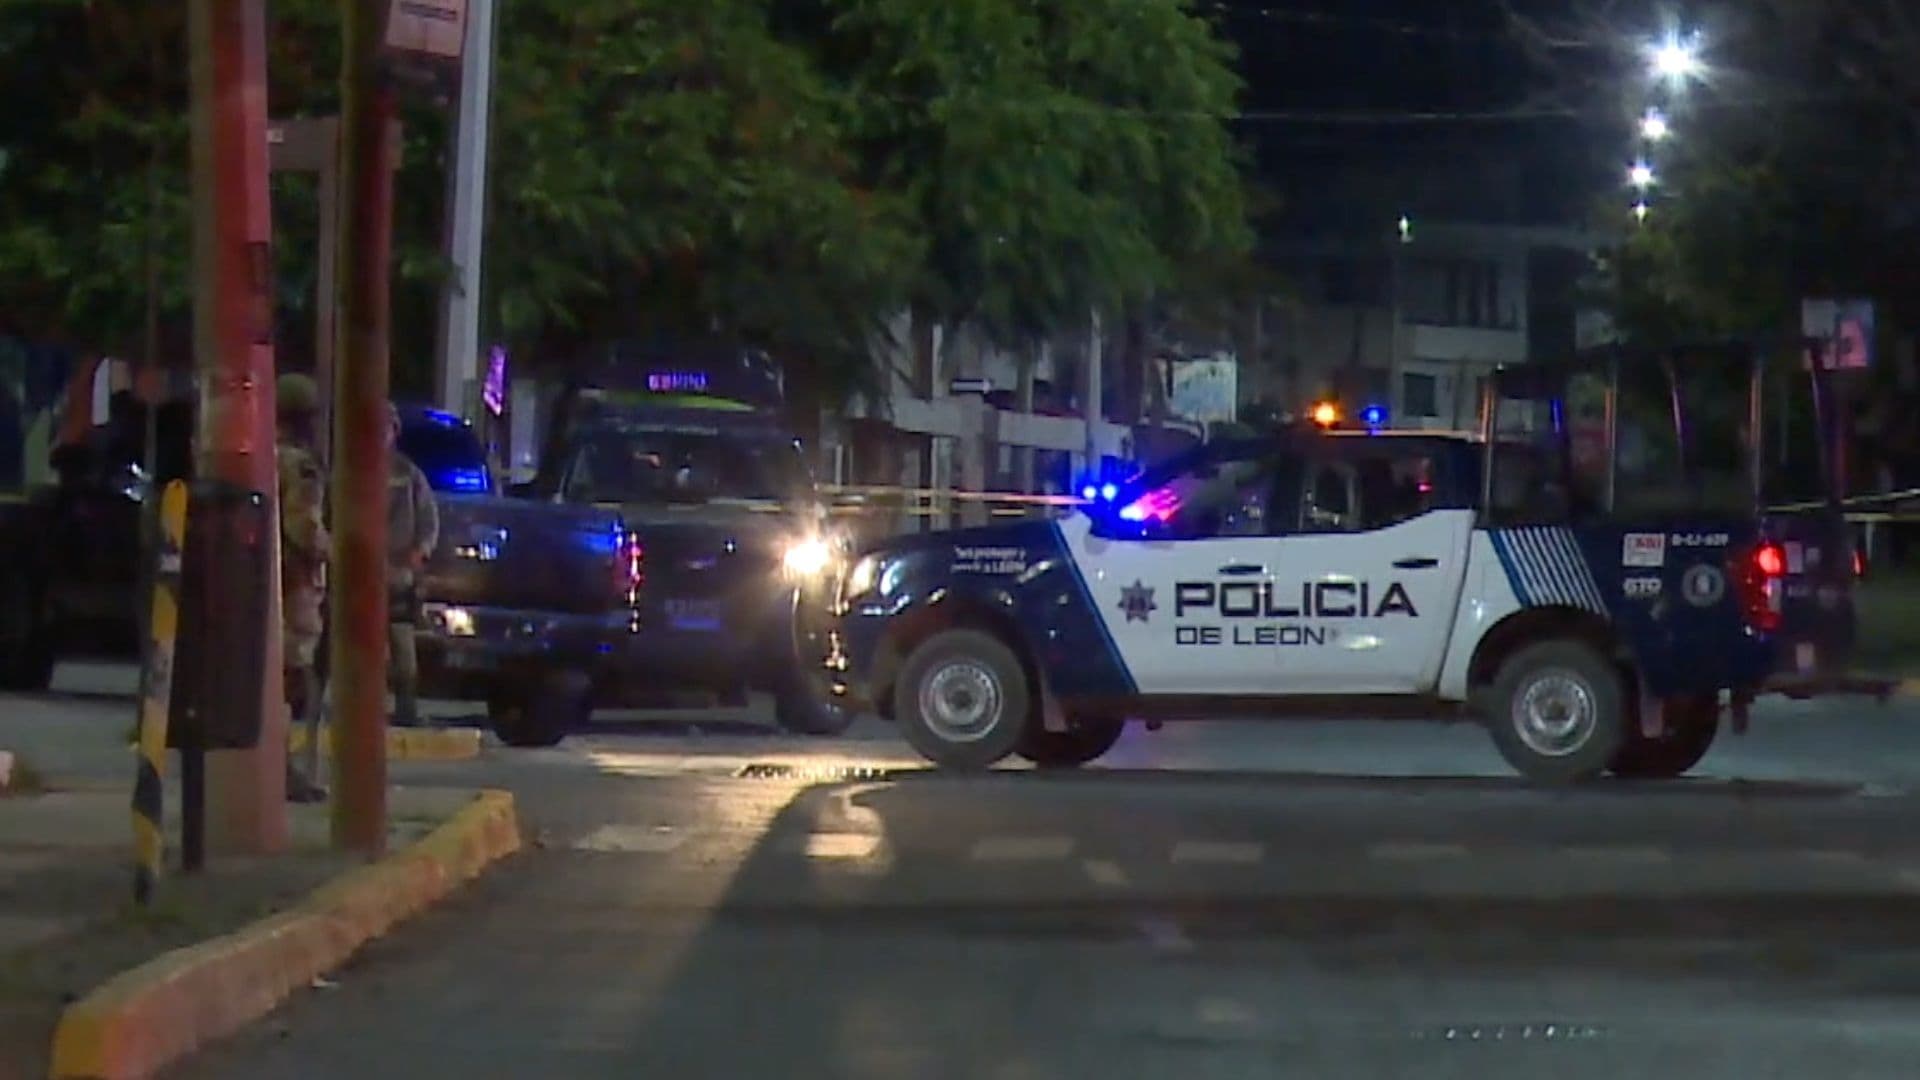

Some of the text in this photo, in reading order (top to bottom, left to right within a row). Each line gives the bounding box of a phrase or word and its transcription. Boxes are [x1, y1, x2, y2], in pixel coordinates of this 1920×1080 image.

[1174, 581, 1418, 617] POLICIA
[1175, 627, 1325, 645] DE LEON
